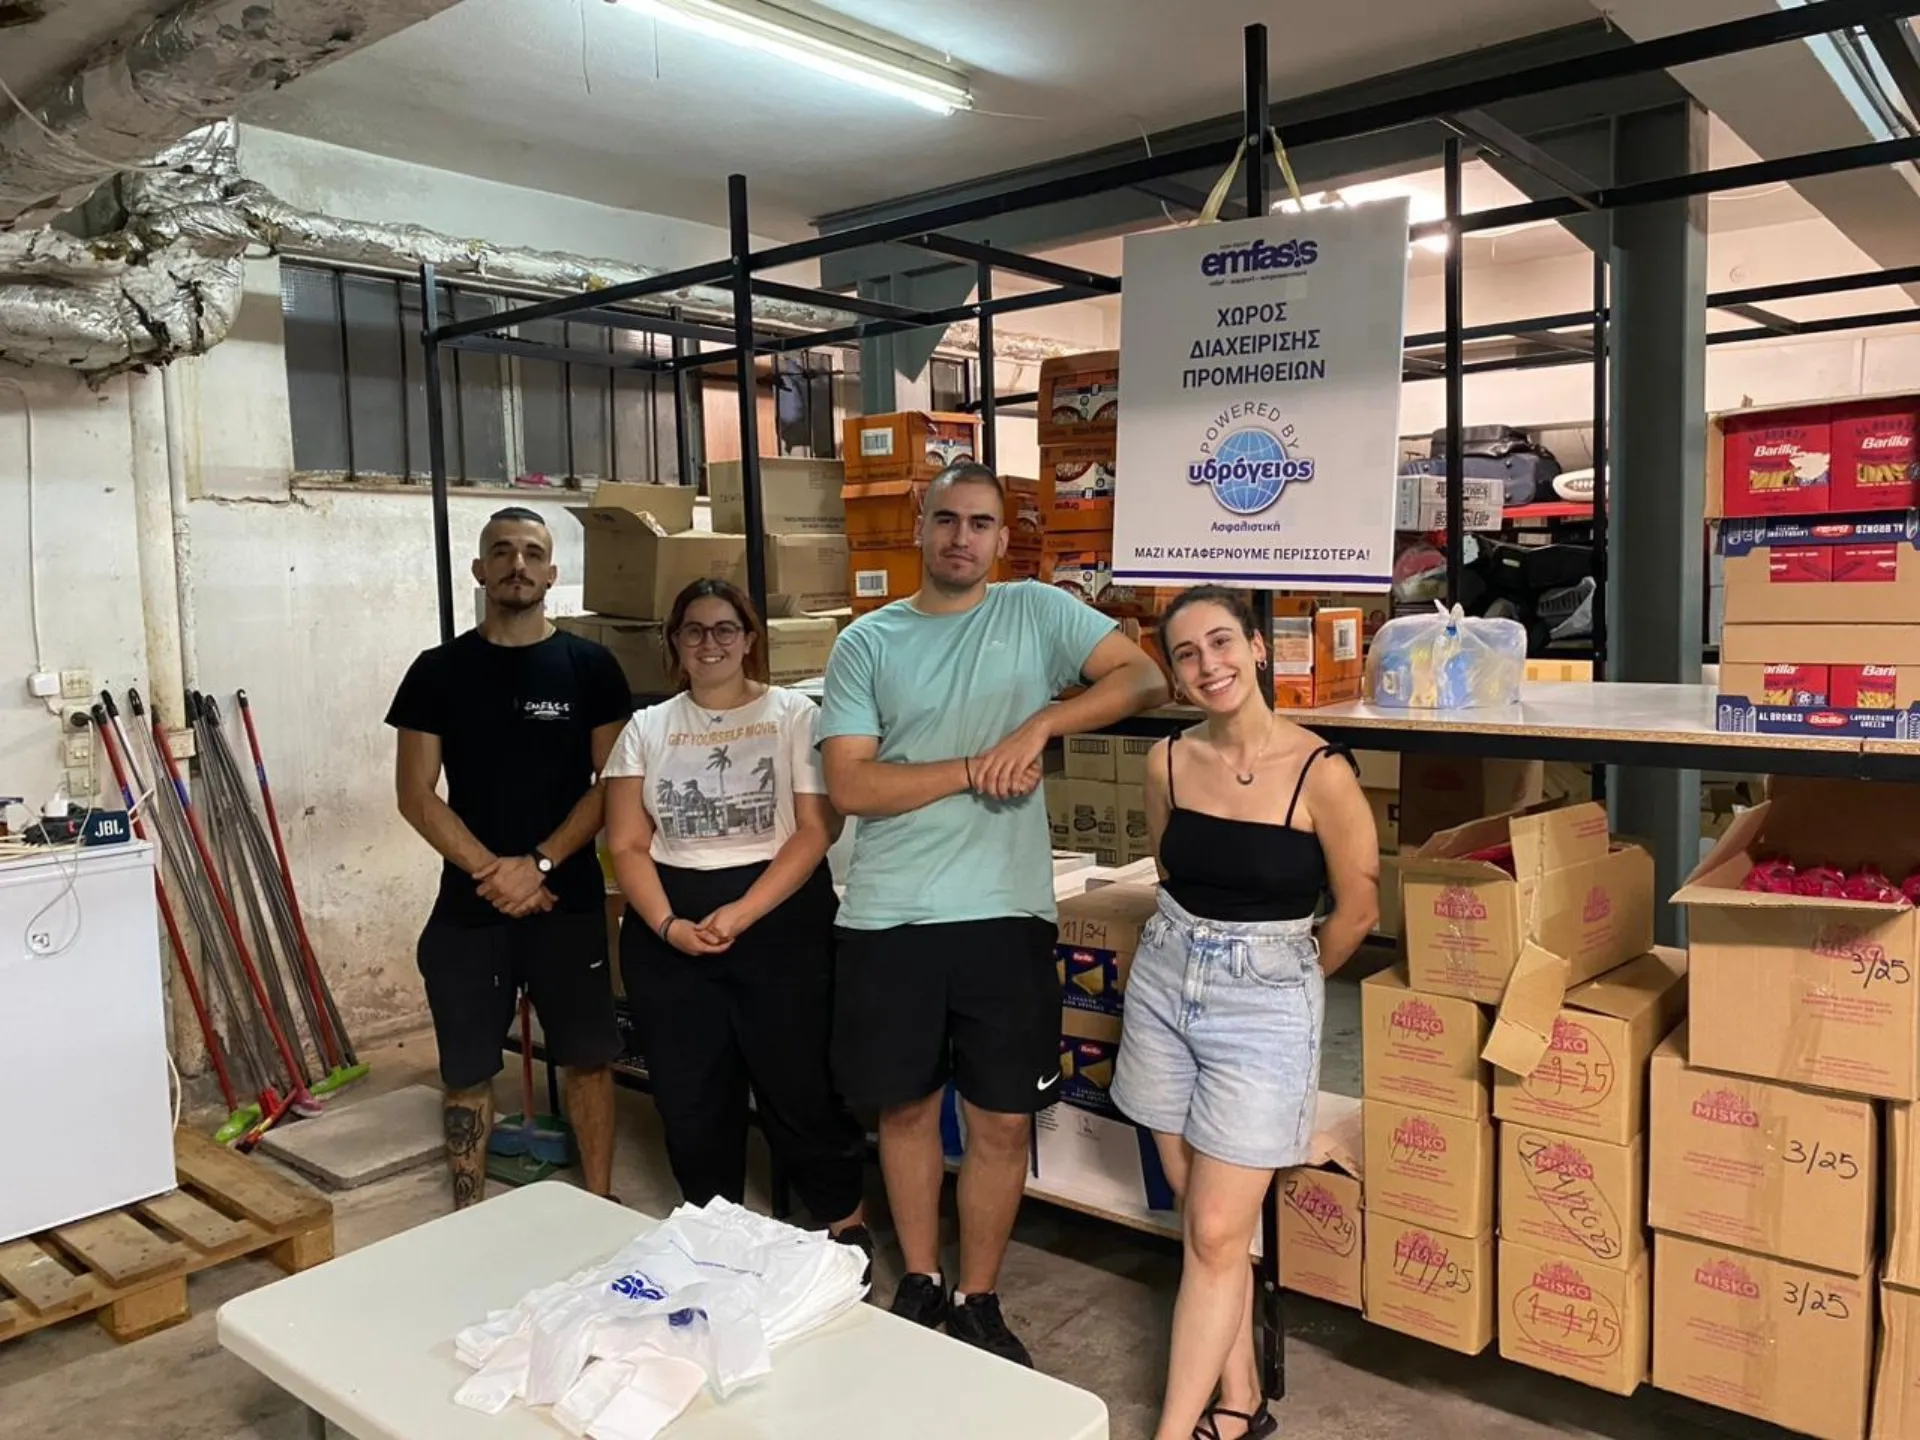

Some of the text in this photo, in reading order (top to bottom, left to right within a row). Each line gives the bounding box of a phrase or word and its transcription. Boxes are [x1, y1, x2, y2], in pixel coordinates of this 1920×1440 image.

[1217, 302, 1287, 327] ΧΩΡΟΣ
[1190, 329, 1320, 359] ΔΙΑΧΕΙΡΙΣΗΣ
[1183, 359, 1325, 388] ΠΡΟΜΗΘΕΙΩΝ
[1200, 401, 1300, 454] POWERED BY
[1754, 444, 1800, 457] Barilla
[1862, 435, 1912, 449] Barilla
[1189, 457, 1311, 485] υδρόγειος
[1211, 521, 1281, 533] Ασφαλιστική
[1135, 547, 1370, 561] ΜΑΖΙ ΚΑΤΑΦΕΡΝΟΥΜΕ ΠΕΡΙΣΣΟΤΕΡΑ!
[1764, 665, 1798, 675] arilla
[1758, 711, 1804, 723] AL BRONZO
[1810, 715, 1844, 725] Barilla
[690, 727, 744, 745] YOURSELF
[95, 820, 123, 837] JBL
[1435, 903, 1485, 918] MISKO
[1063, 920, 1106, 948] 11/24
[1850, 951, 1911, 989] 3/25
[1394, 1012, 1442, 1033] MISKO
[1552, 1036, 1587, 1052] SKO
[1694, 1102, 1758, 1127] MISKO
[1395, 1130, 1445, 1151] MISKO
[1536, 1154, 1593, 1179] MISKO
[1782, 1139, 1858, 1179] 3/25
[1533, 1275, 1591, 1300] MISKO
[1695, 1270, 1758, 1298] MISKO
[1783, 1281, 1849, 1319] 3/25
